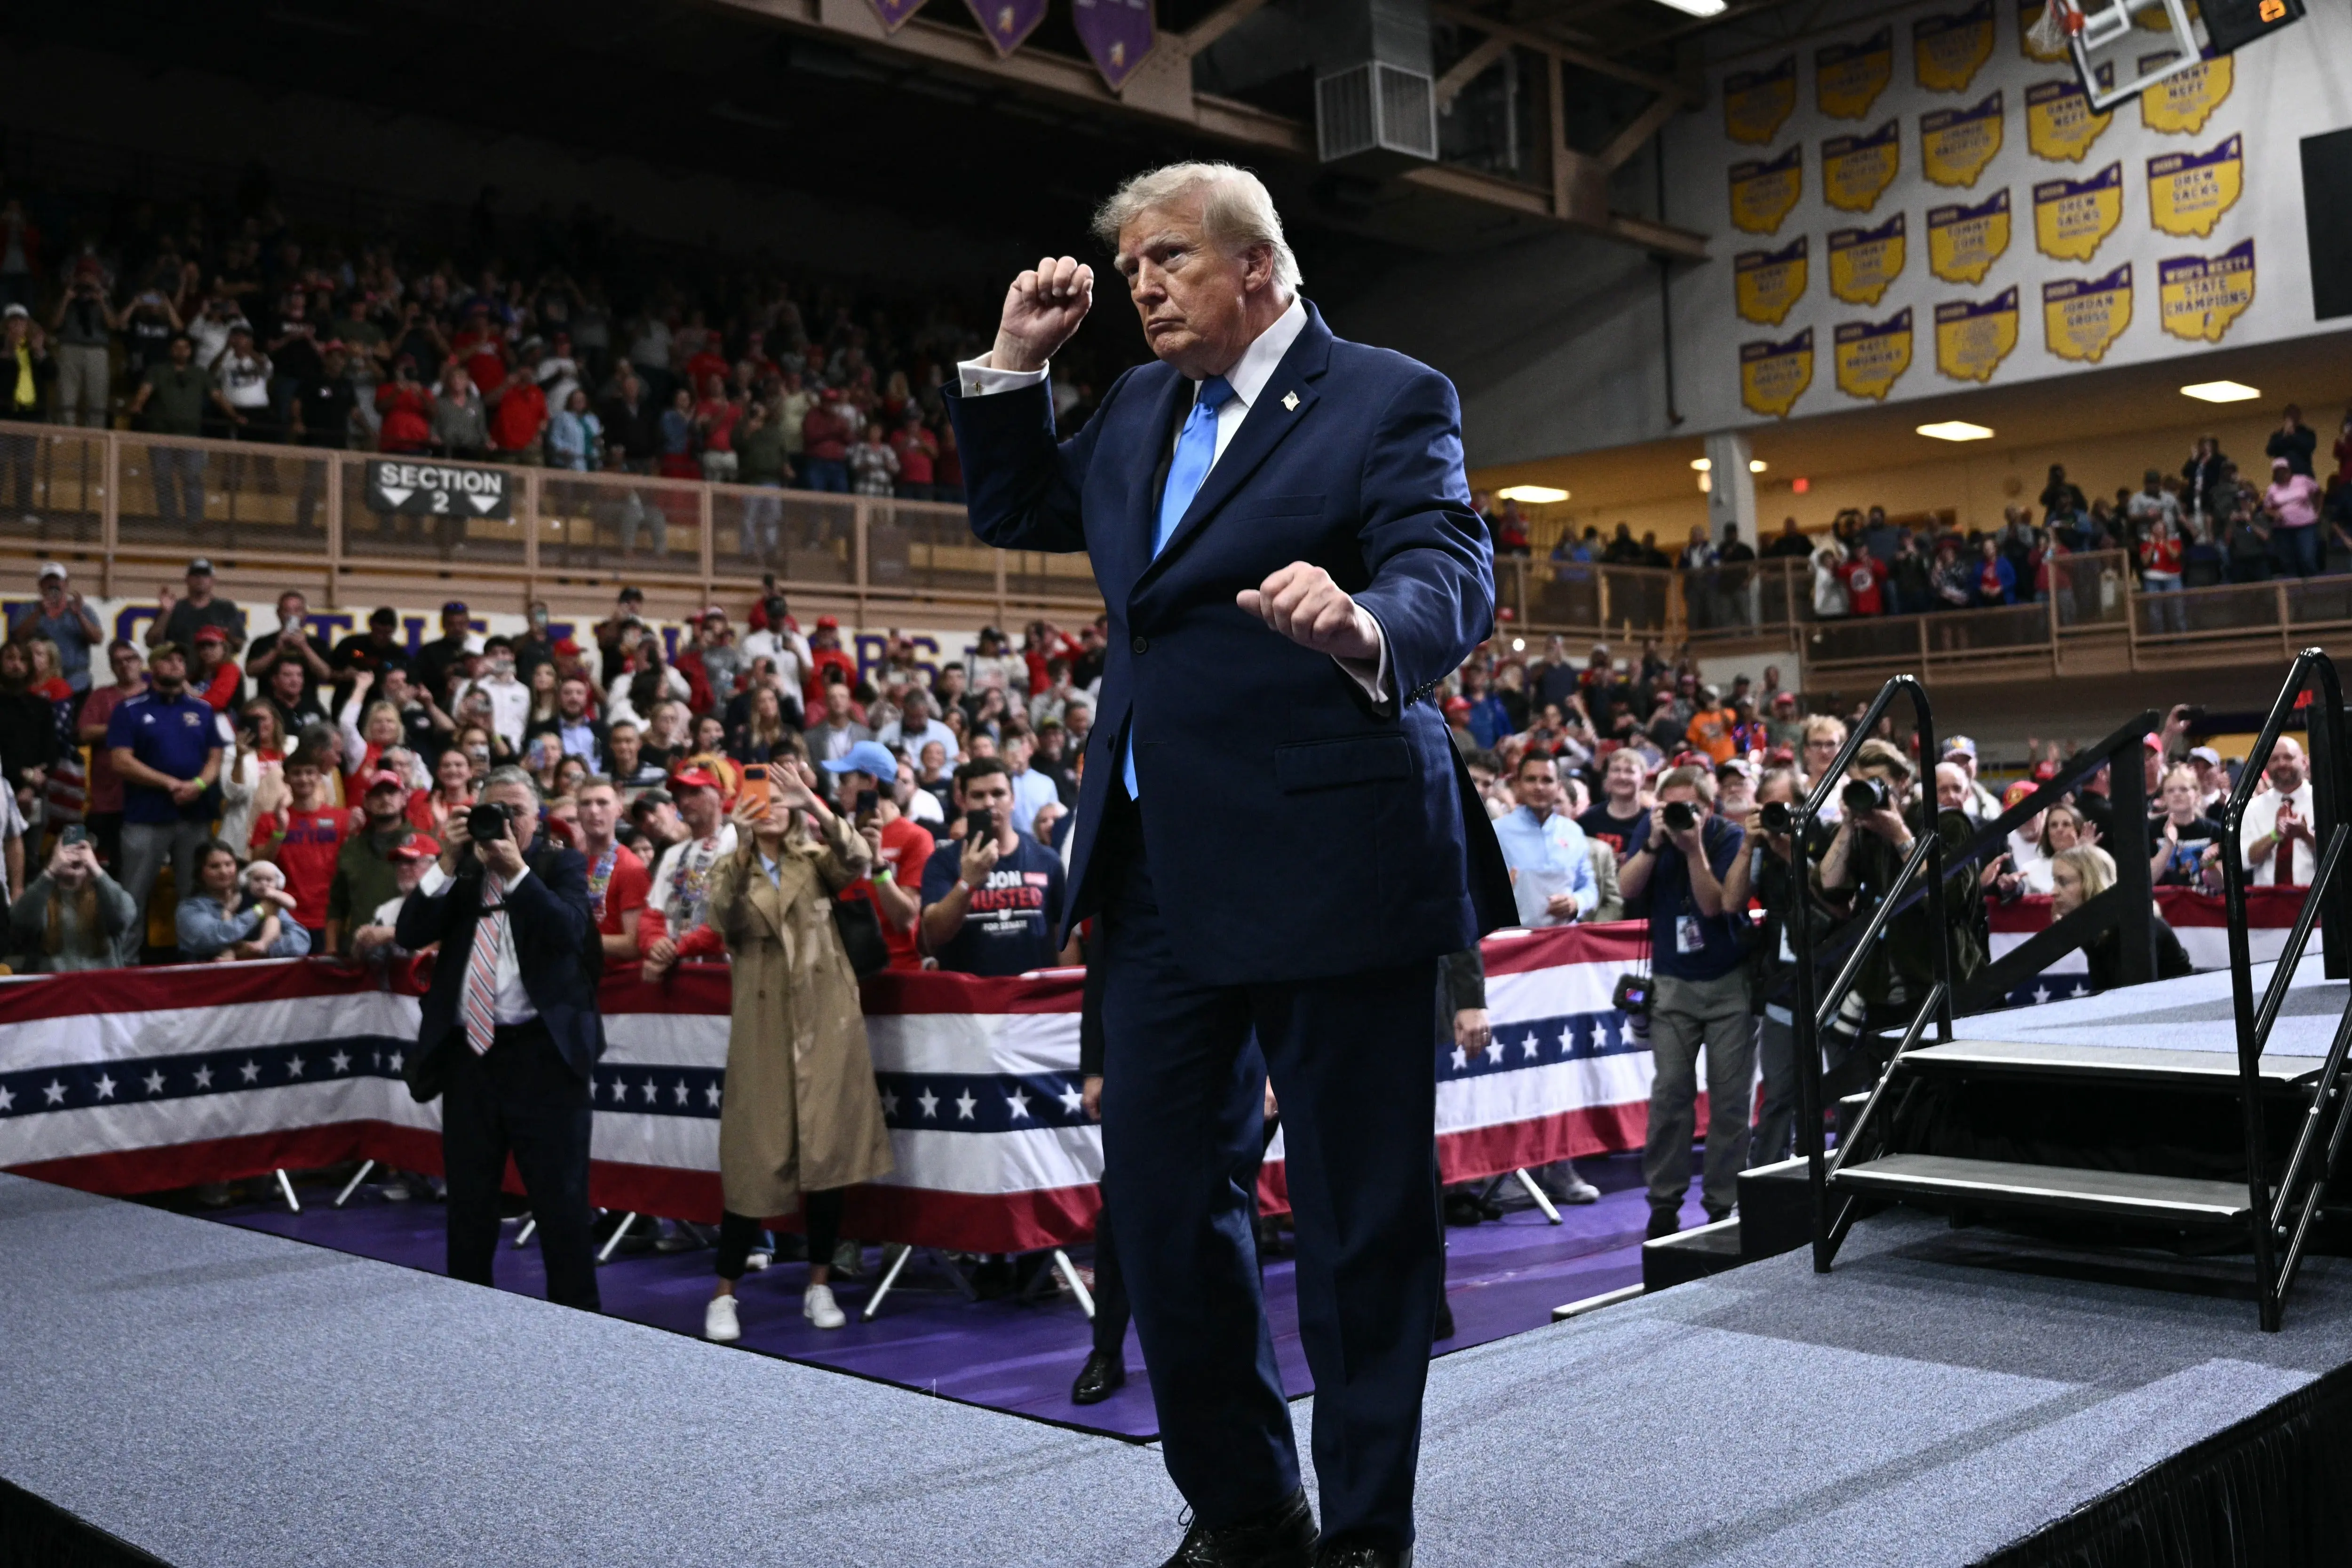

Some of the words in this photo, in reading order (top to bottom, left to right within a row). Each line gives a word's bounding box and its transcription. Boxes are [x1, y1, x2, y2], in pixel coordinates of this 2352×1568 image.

[2165, 292, 2248, 316] CHAMPIONS
[380, 462, 501, 494] SECTION
[431, 490, 450, 513] 2
[985, 870, 1022, 888] JON
[983, 922, 999, 931] FOR
[1001, 919, 1027, 930] SENATE
